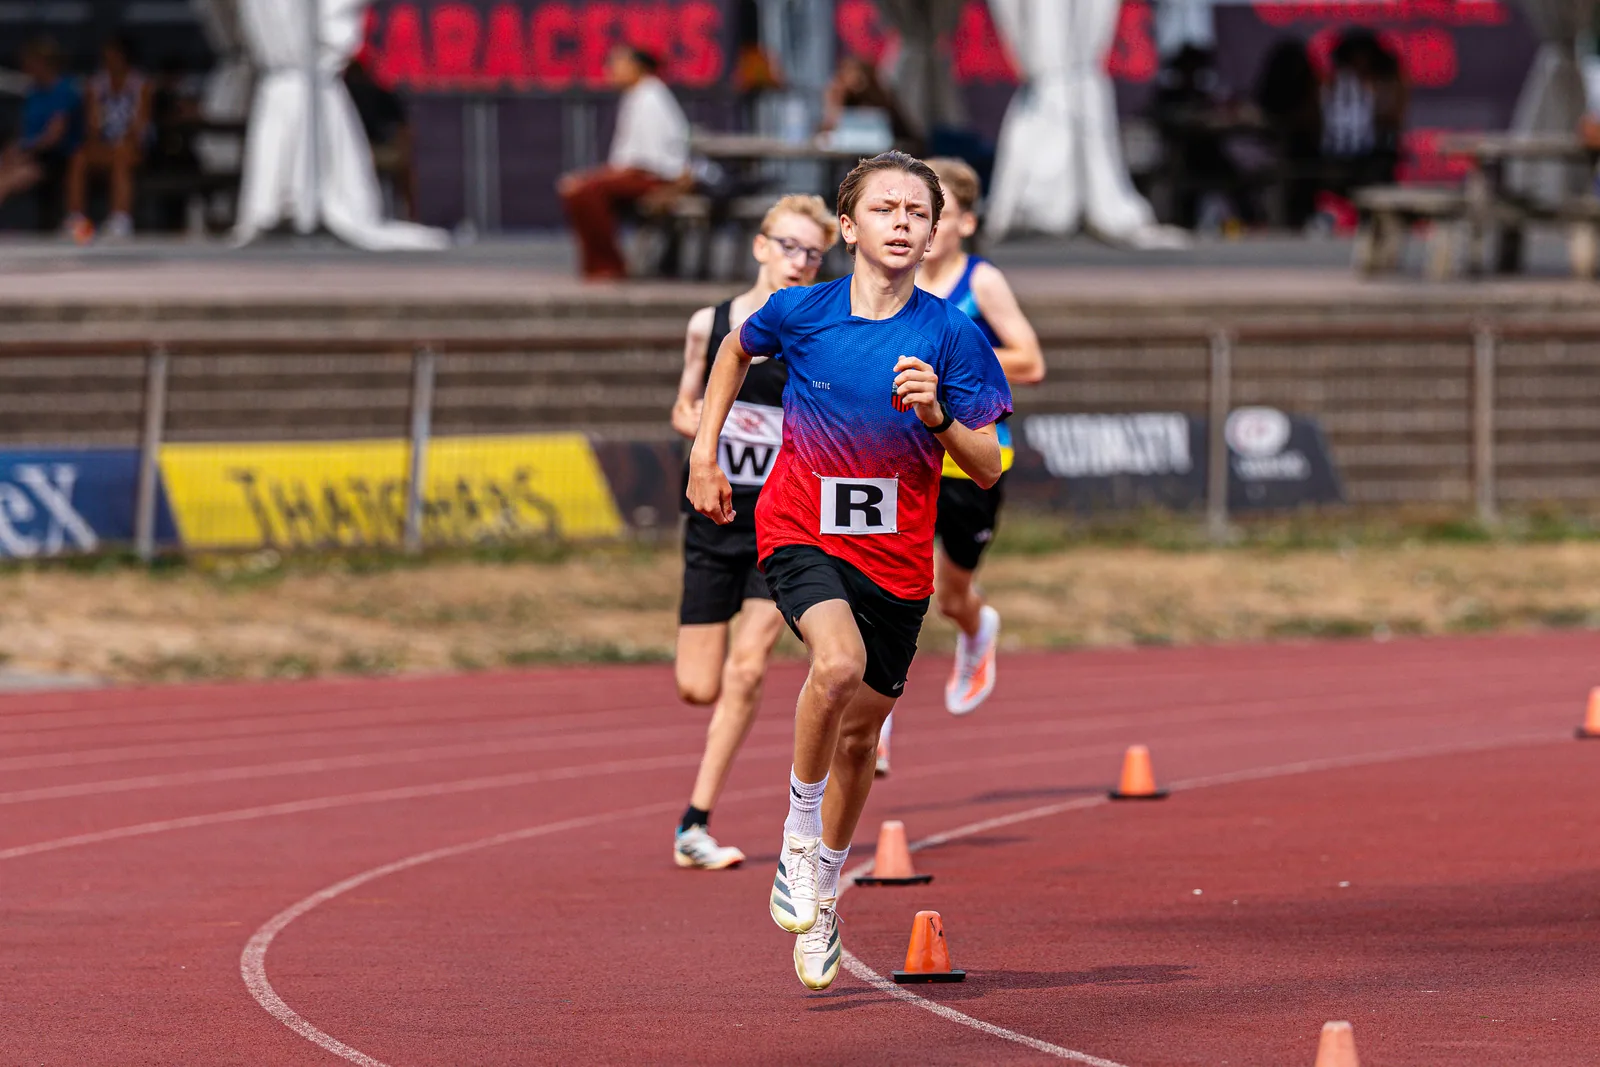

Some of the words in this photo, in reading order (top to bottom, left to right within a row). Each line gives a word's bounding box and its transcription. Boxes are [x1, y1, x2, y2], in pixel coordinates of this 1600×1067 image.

[812, 380, 831, 390] TACTIC
[725, 443, 774, 476] W
[835, 483, 884, 527] R
